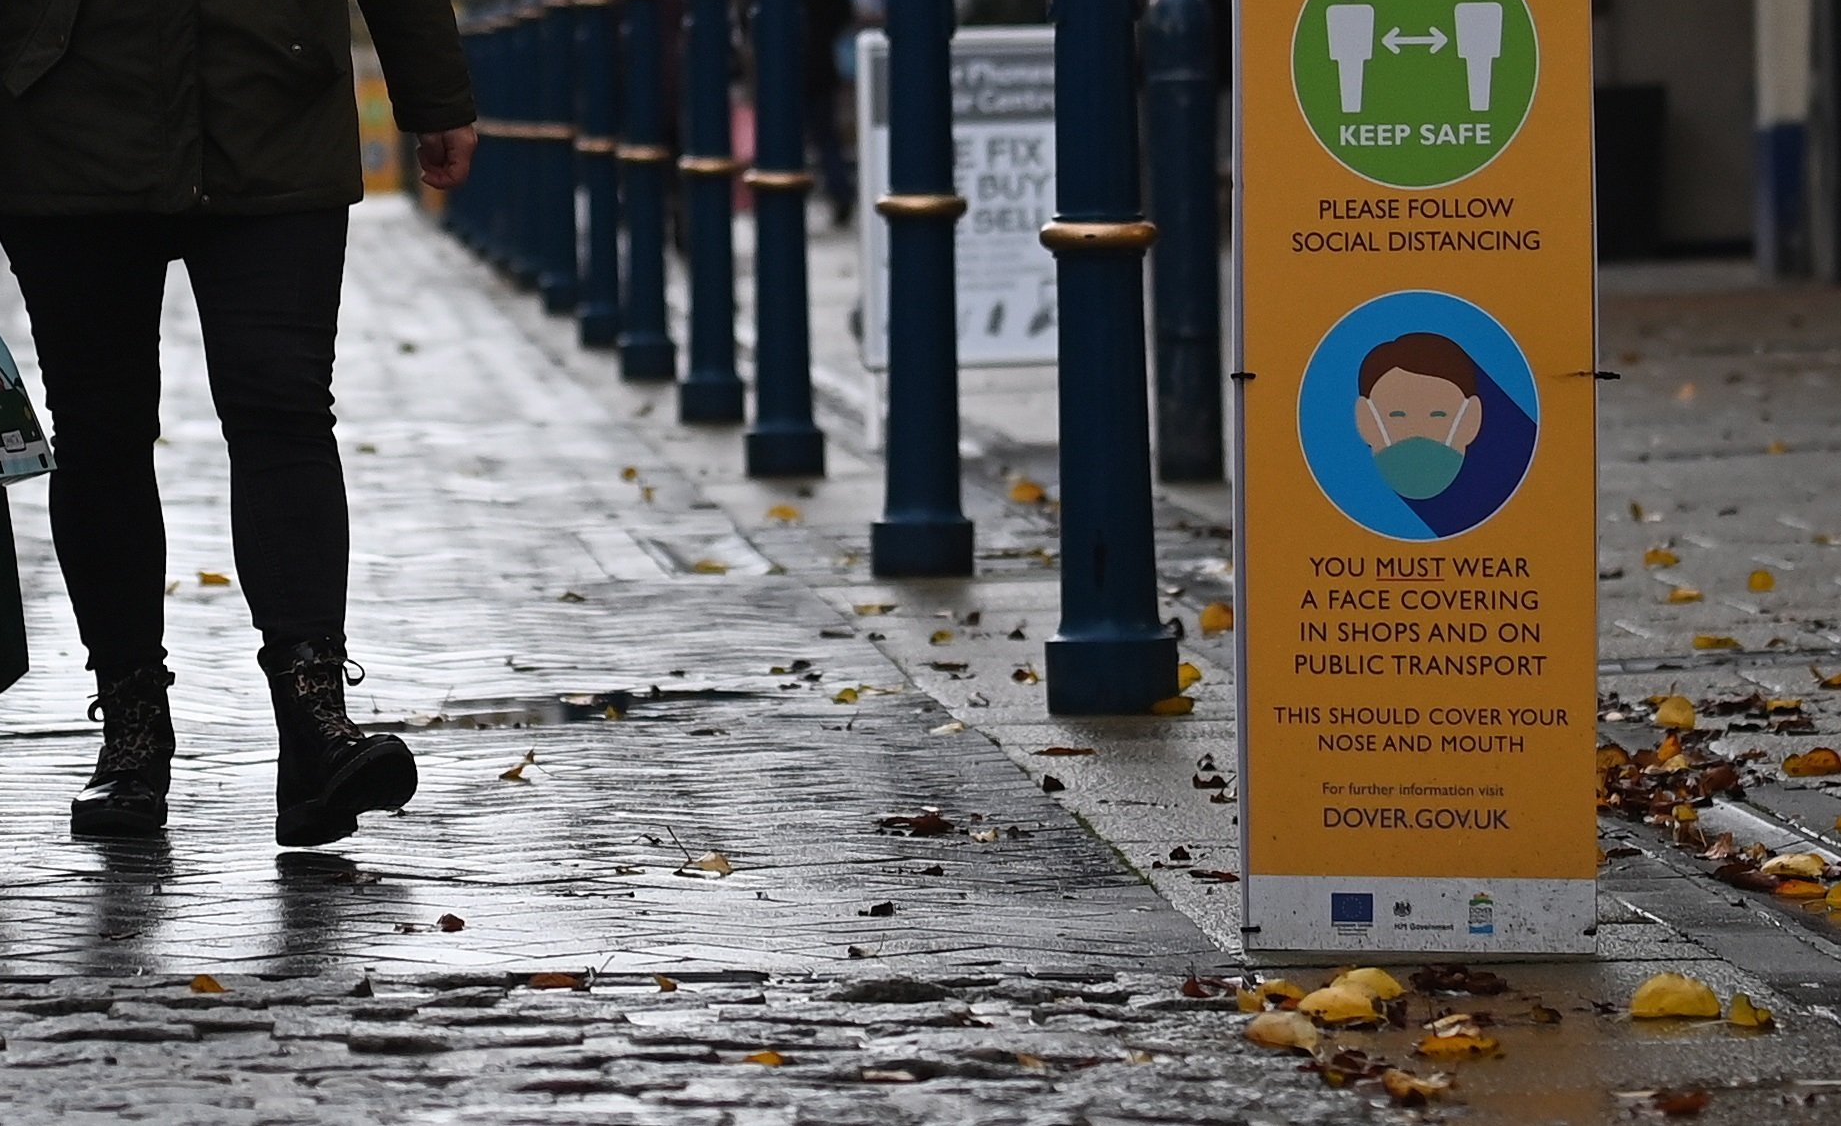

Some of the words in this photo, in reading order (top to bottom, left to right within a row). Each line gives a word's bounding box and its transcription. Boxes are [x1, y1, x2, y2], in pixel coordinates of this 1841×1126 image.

[1340, 125, 1410, 145] KEEP
[1420, 124, 1490, 145] SAFE
[987, 137, 1042, 168] FIX
[977, 174, 1052, 201] BUY
[1320, 199, 1399, 219] PLEASE
[1409, 198, 1514, 218] FOLLOW
[1293, 232, 1380, 252] SOCIAL
[1389, 230, 1540, 251] DISTANCING
[1310, 557, 1364, 577] YOU
[1377, 558, 1445, 578] MUST
[1453, 558, 1529, 577] WEAR
[1301, 590, 1317, 609] A
[1329, 590, 1390, 609] FACE
[1401, 590, 1538, 610] COVERING
[1301, 622, 1326, 641] IN
[1338, 623, 1420, 642] SHOPS
[1428, 623, 1487, 642] AND
[1499, 623, 1539, 642] ON
[1295, 655, 1384, 674] PUBLIC
[1391, 655, 1547, 675] TRANSPORT
[1274, 707, 1320, 724] THIS
[1330, 708, 1420, 724] SHOULD
[1429, 708, 1502, 725] COVER
[1508, 709, 1568, 725] YOUR
[1319, 735, 1376, 751] NOSE
[1383, 735, 1432, 752] AND
[1442, 736, 1523, 752] MOUTH
[1323, 782, 1344, 794] For
[1349, 782, 1394, 795] further
[1399, 783, 1474, 796] information
[1479, 785, 1504, 796] visit
[1324, 808, 1509, 829] DOVER.GOV.UK
